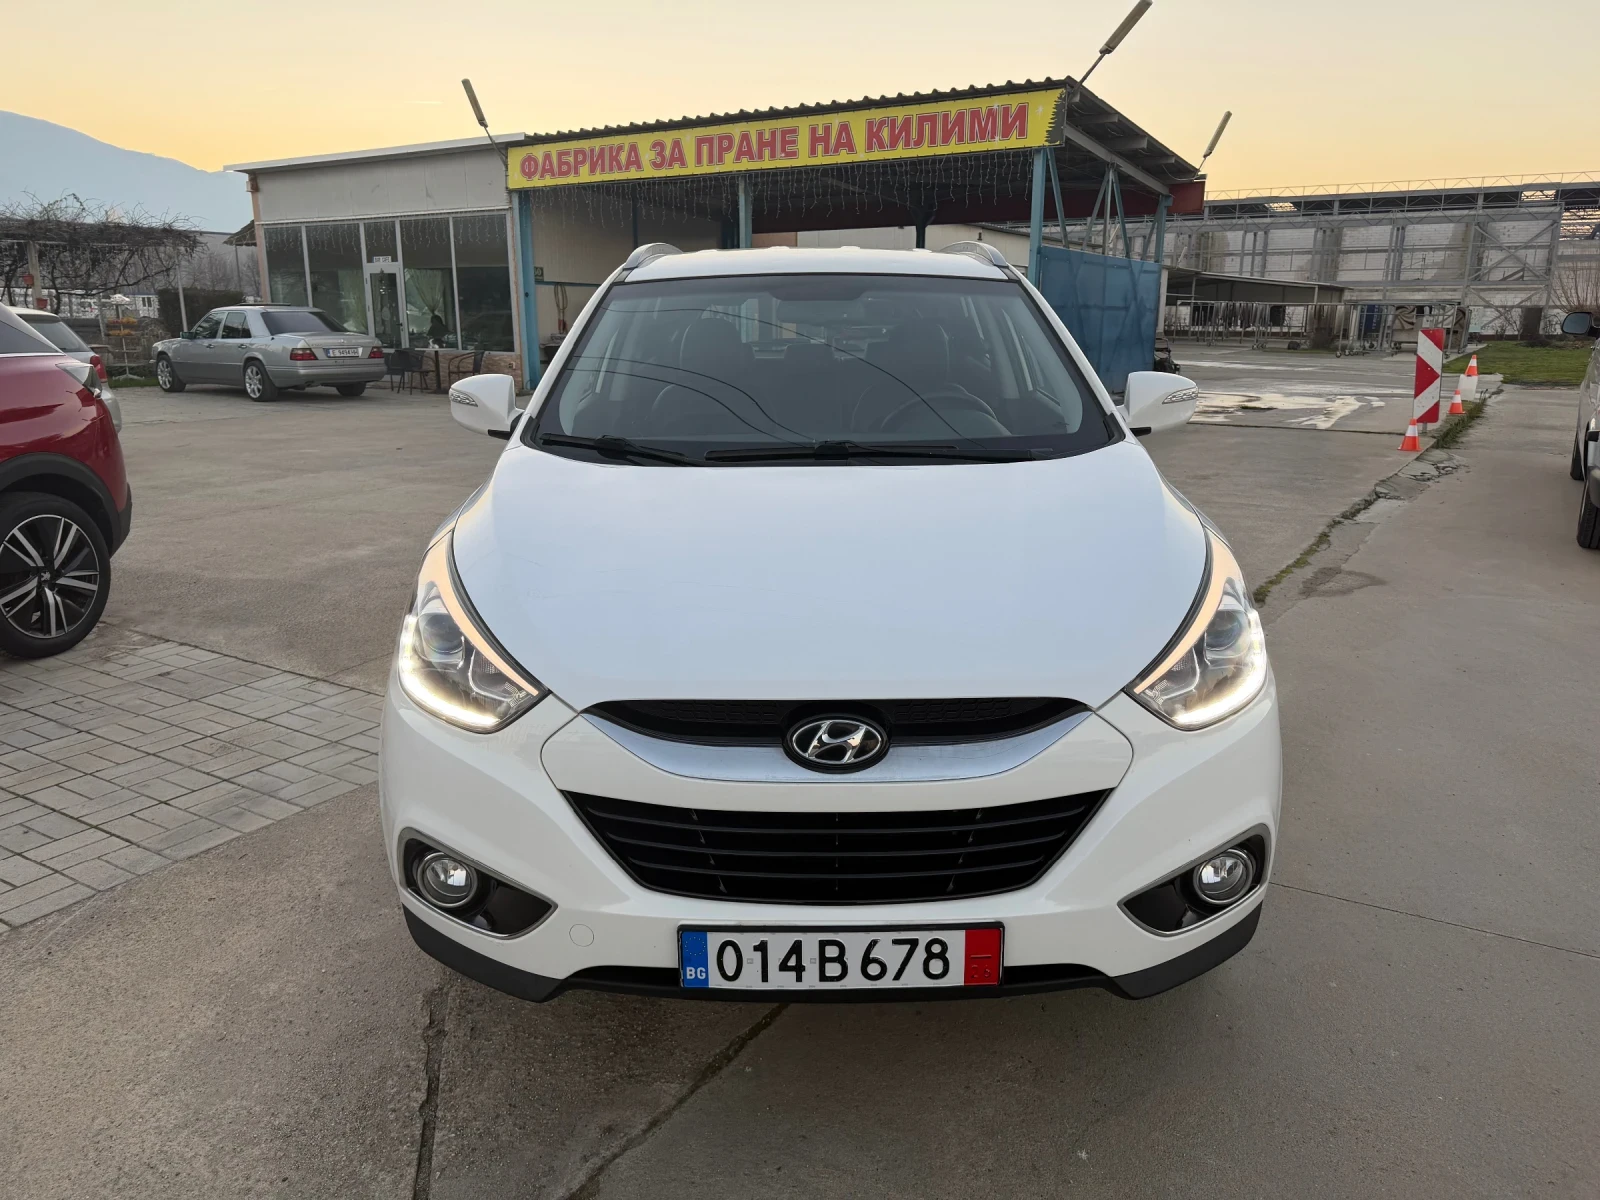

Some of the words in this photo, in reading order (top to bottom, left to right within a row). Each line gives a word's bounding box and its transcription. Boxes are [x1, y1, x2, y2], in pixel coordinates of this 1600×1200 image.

[520, 143, 643, 181] ФАБРИКА
[649, 138, 688, 170] ЗА
[695, 126, 799, 167] ПРАНЕ
[808, 121, 857, 158] НА
[865, 102, 1029, 153] КИЛИМИ
[686, 966, 706, 979] BG
